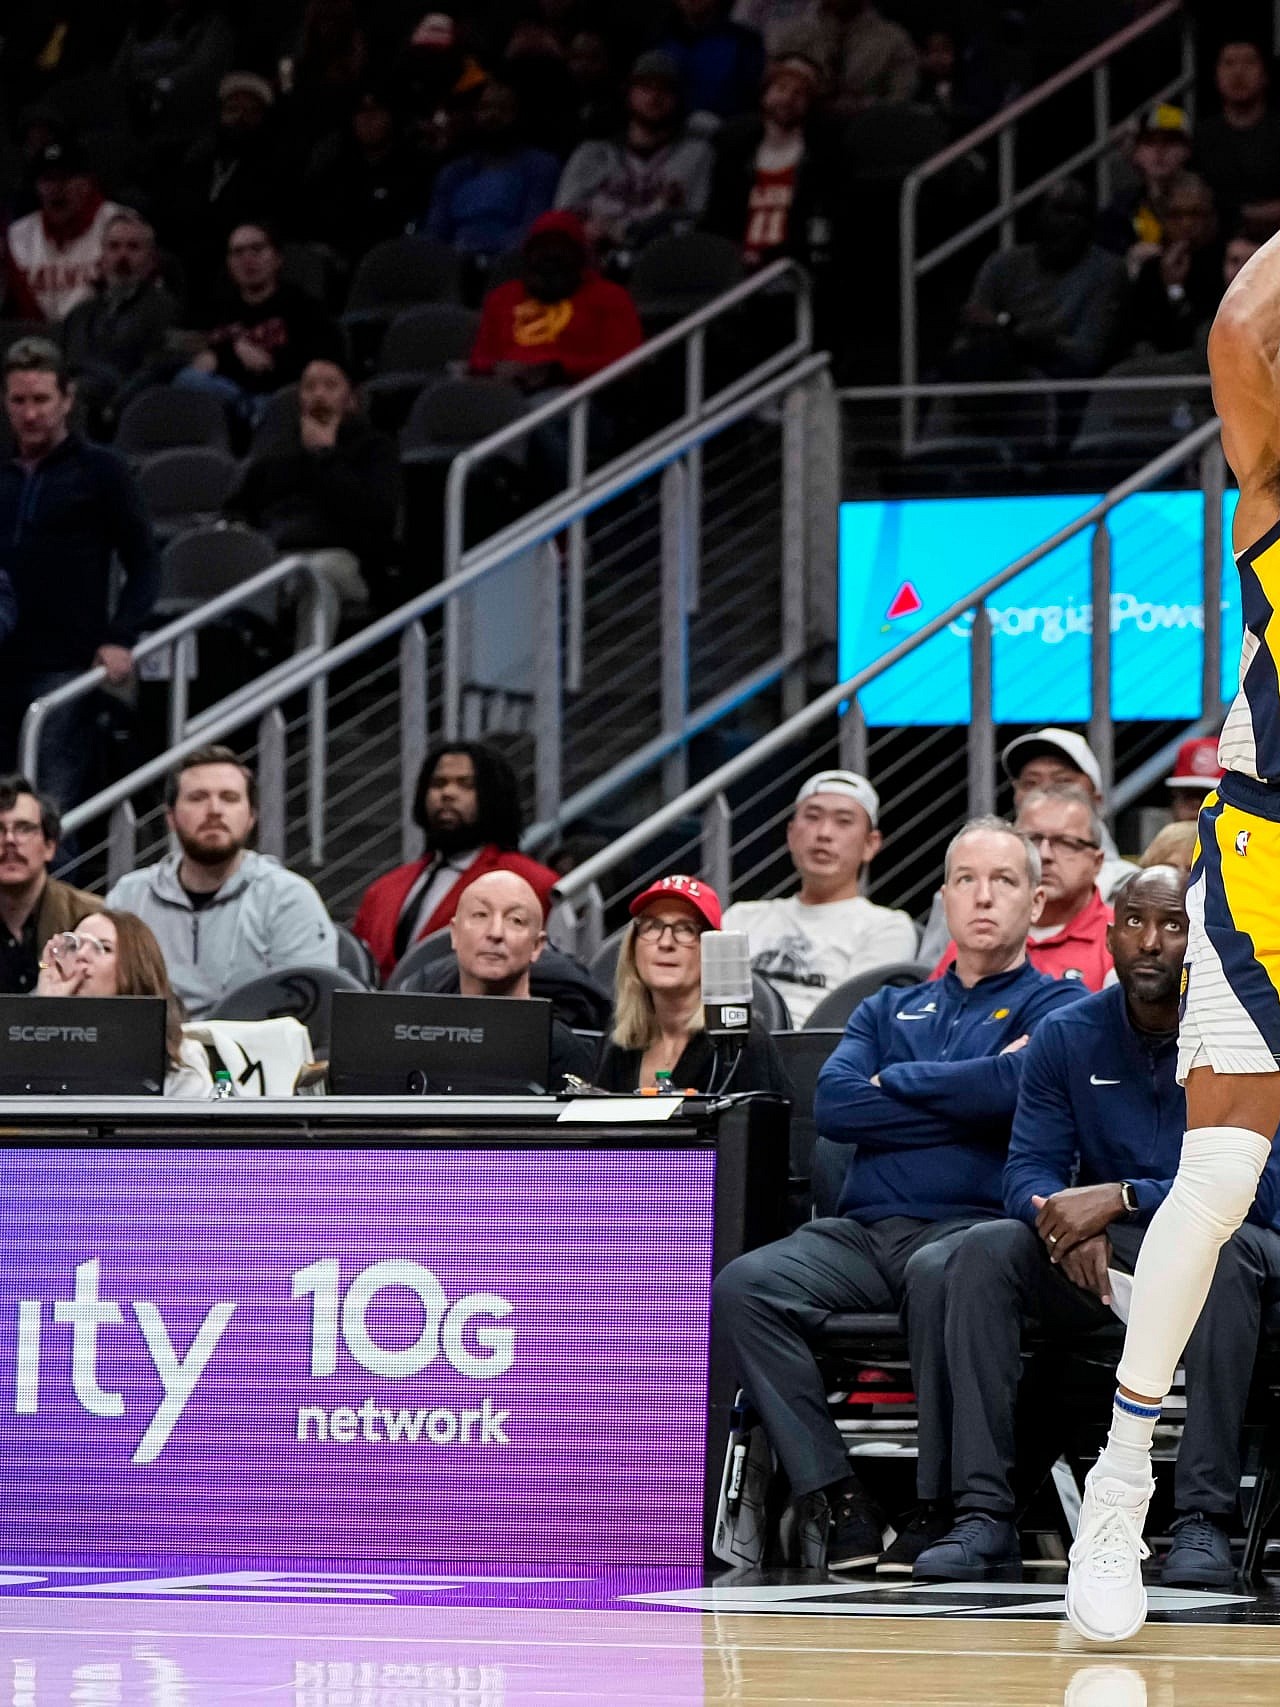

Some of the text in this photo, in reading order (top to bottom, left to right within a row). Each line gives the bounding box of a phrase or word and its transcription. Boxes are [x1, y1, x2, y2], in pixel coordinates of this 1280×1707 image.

[947, 592, 1230, 644] Gorgia Powe
[8, 1026, 98, 1042] SCEPTRE
[394, 1024, 484, 1043] SCEPTRE
[290, 1258, 516, 1379] 10G
[296, 1398, 513, 1445] network
